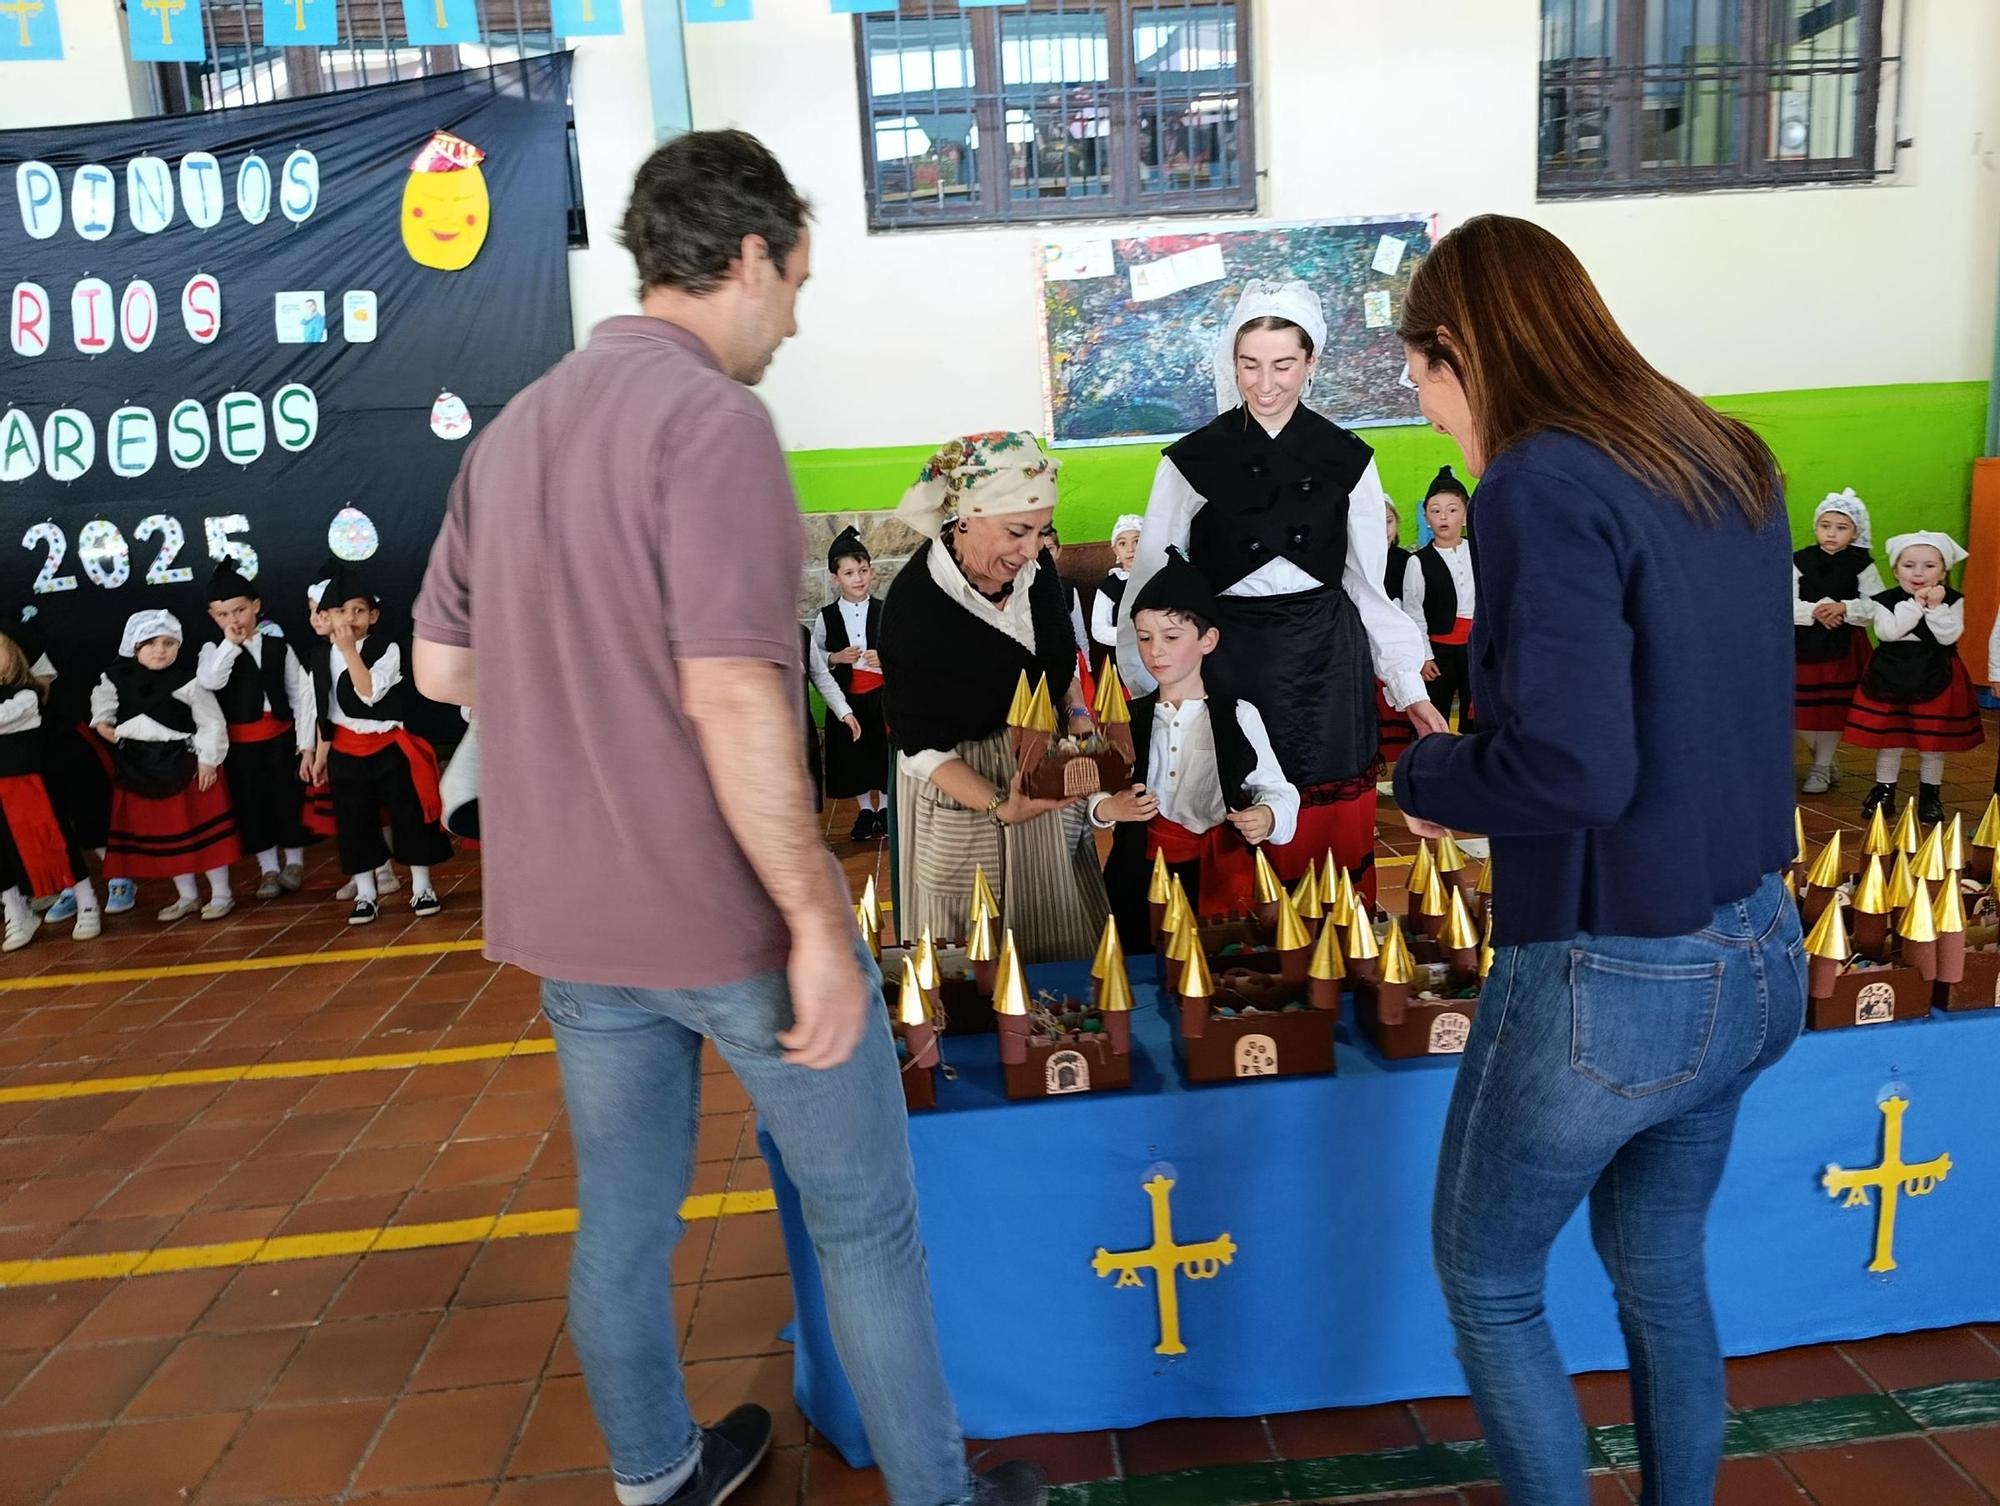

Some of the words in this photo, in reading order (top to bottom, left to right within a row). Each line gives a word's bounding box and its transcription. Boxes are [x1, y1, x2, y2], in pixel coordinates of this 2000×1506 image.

[25, 155, 313, 232] PINTOS
[4, 388, 311, 473] ARESES
[21, 513, 260, 594] 2025
